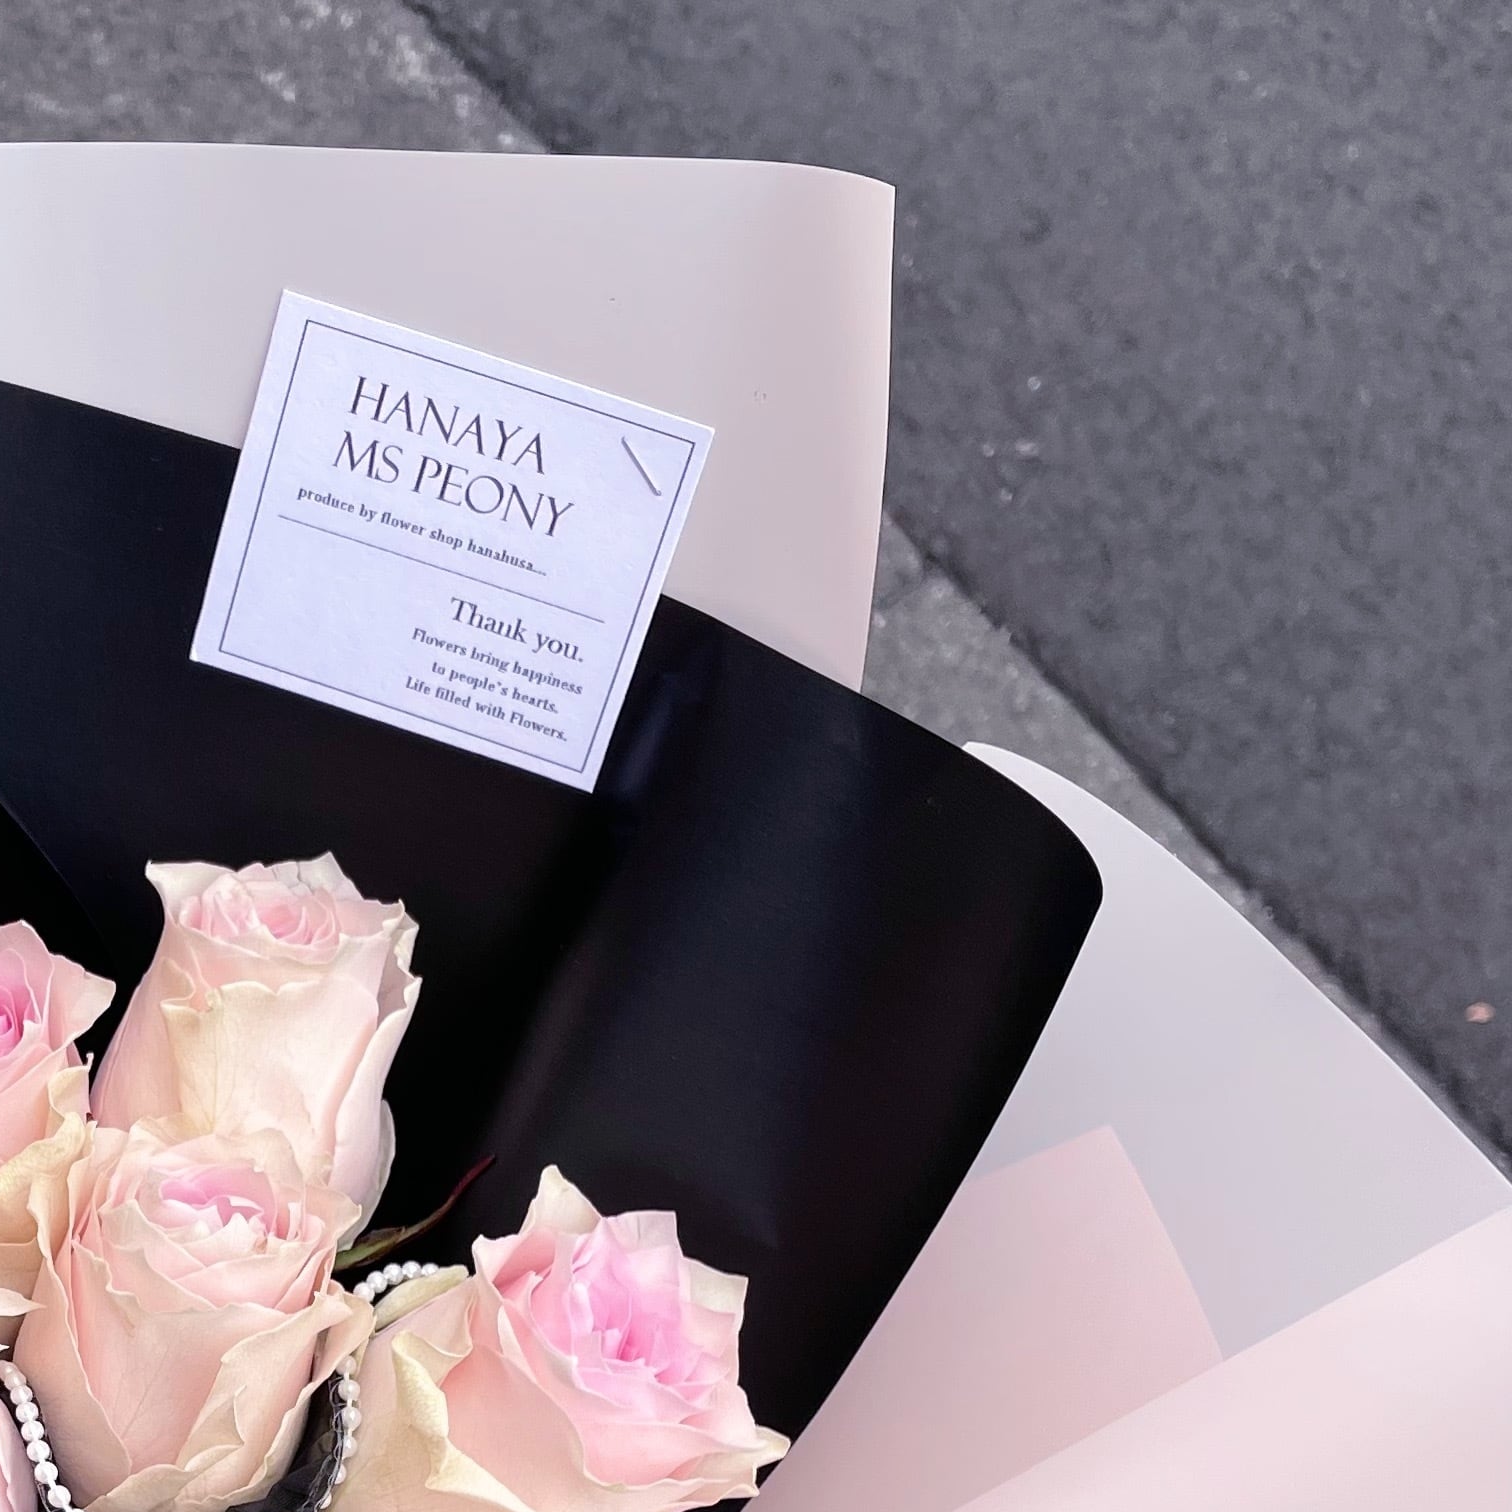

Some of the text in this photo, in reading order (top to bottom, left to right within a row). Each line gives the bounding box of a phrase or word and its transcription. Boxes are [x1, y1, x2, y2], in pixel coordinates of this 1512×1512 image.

[348, 375, 545, 475] HANAYA
[332, 430, 575, 537] MS PEONY
[296, 486, 355, 514] produce
[359, 503, 378, 523] by
[380, 511, 427, 537] flower
[429, 528, 463, 551] shop
[411, 627, 584, 695] Flowers bring happiness
[450, 596, 585, 663] Thank you.
[405, 675, 568, 742] Life filled with Flowers.
[431, 661, 559, 714] to people's hearts.
